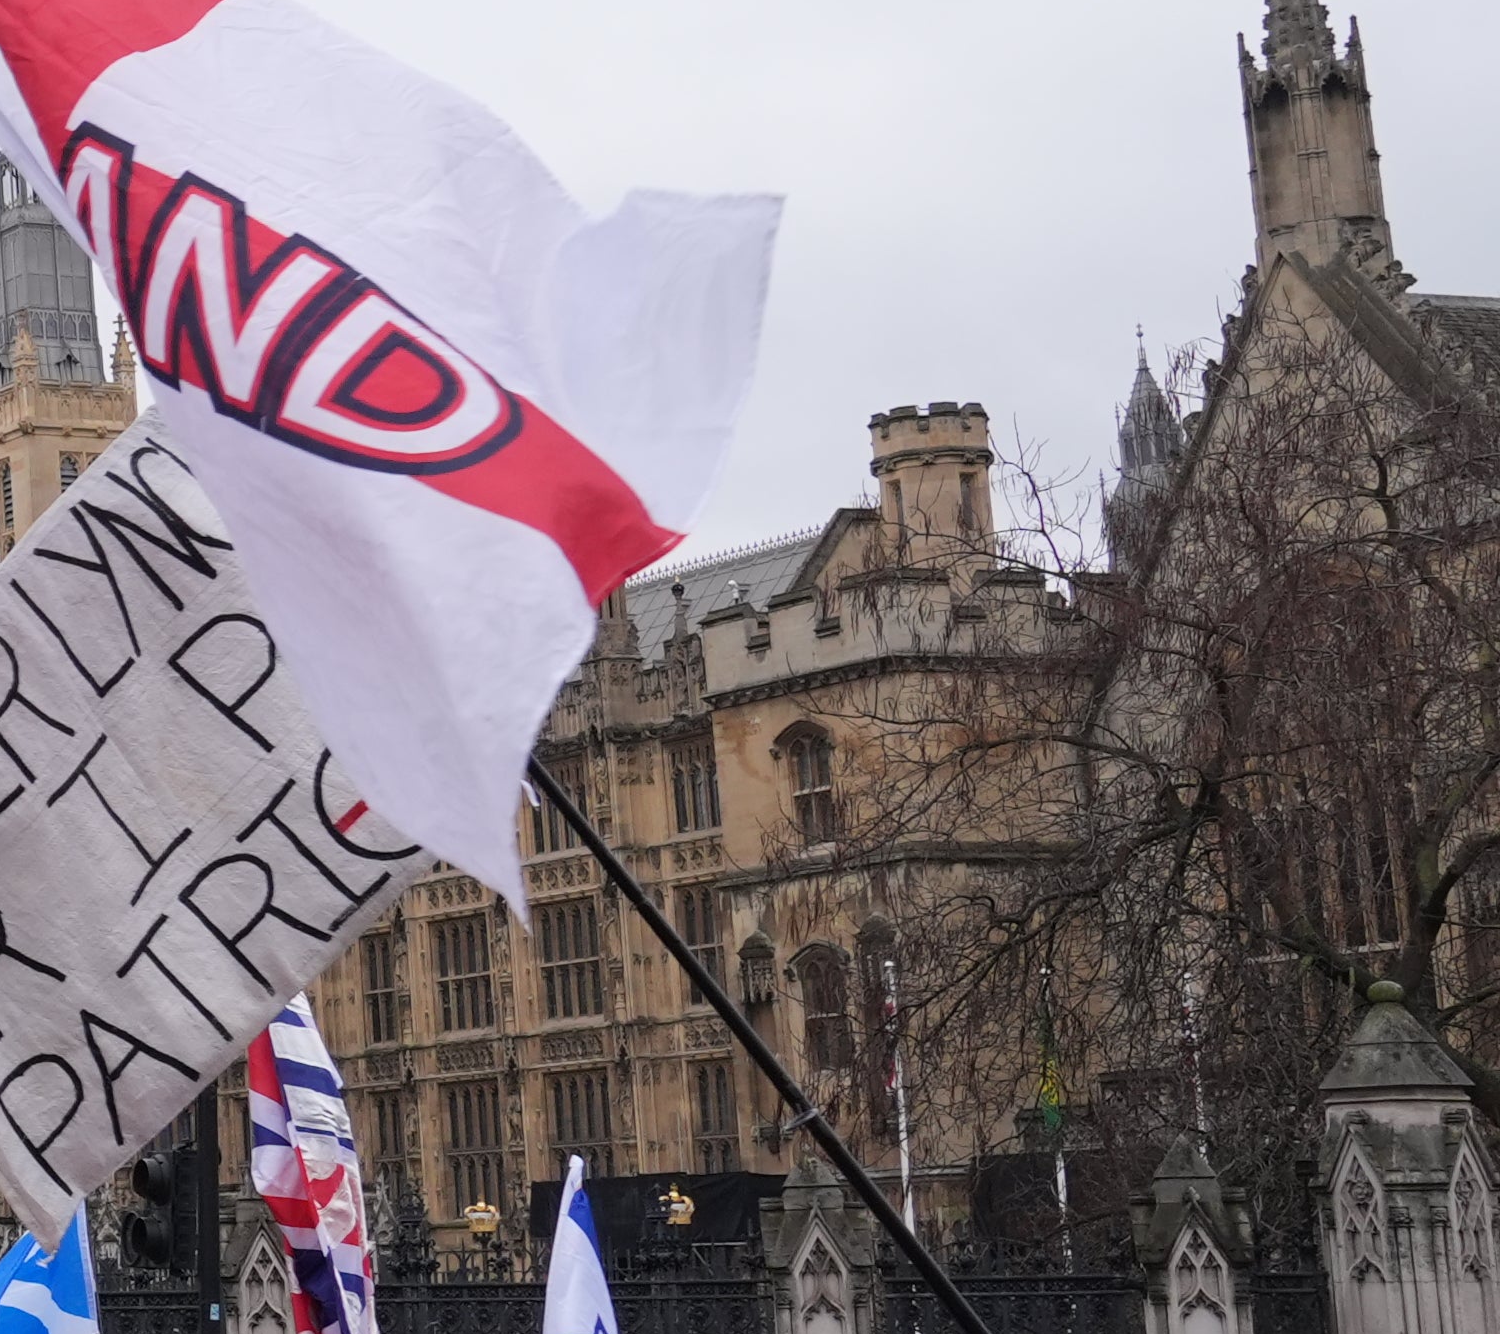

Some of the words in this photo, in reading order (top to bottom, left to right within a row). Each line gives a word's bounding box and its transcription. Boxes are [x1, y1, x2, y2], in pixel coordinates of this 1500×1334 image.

[11, 438, 234, 697] LYNC
[47, 734, 192, 906] I
[168, 612, 277, 753] P
